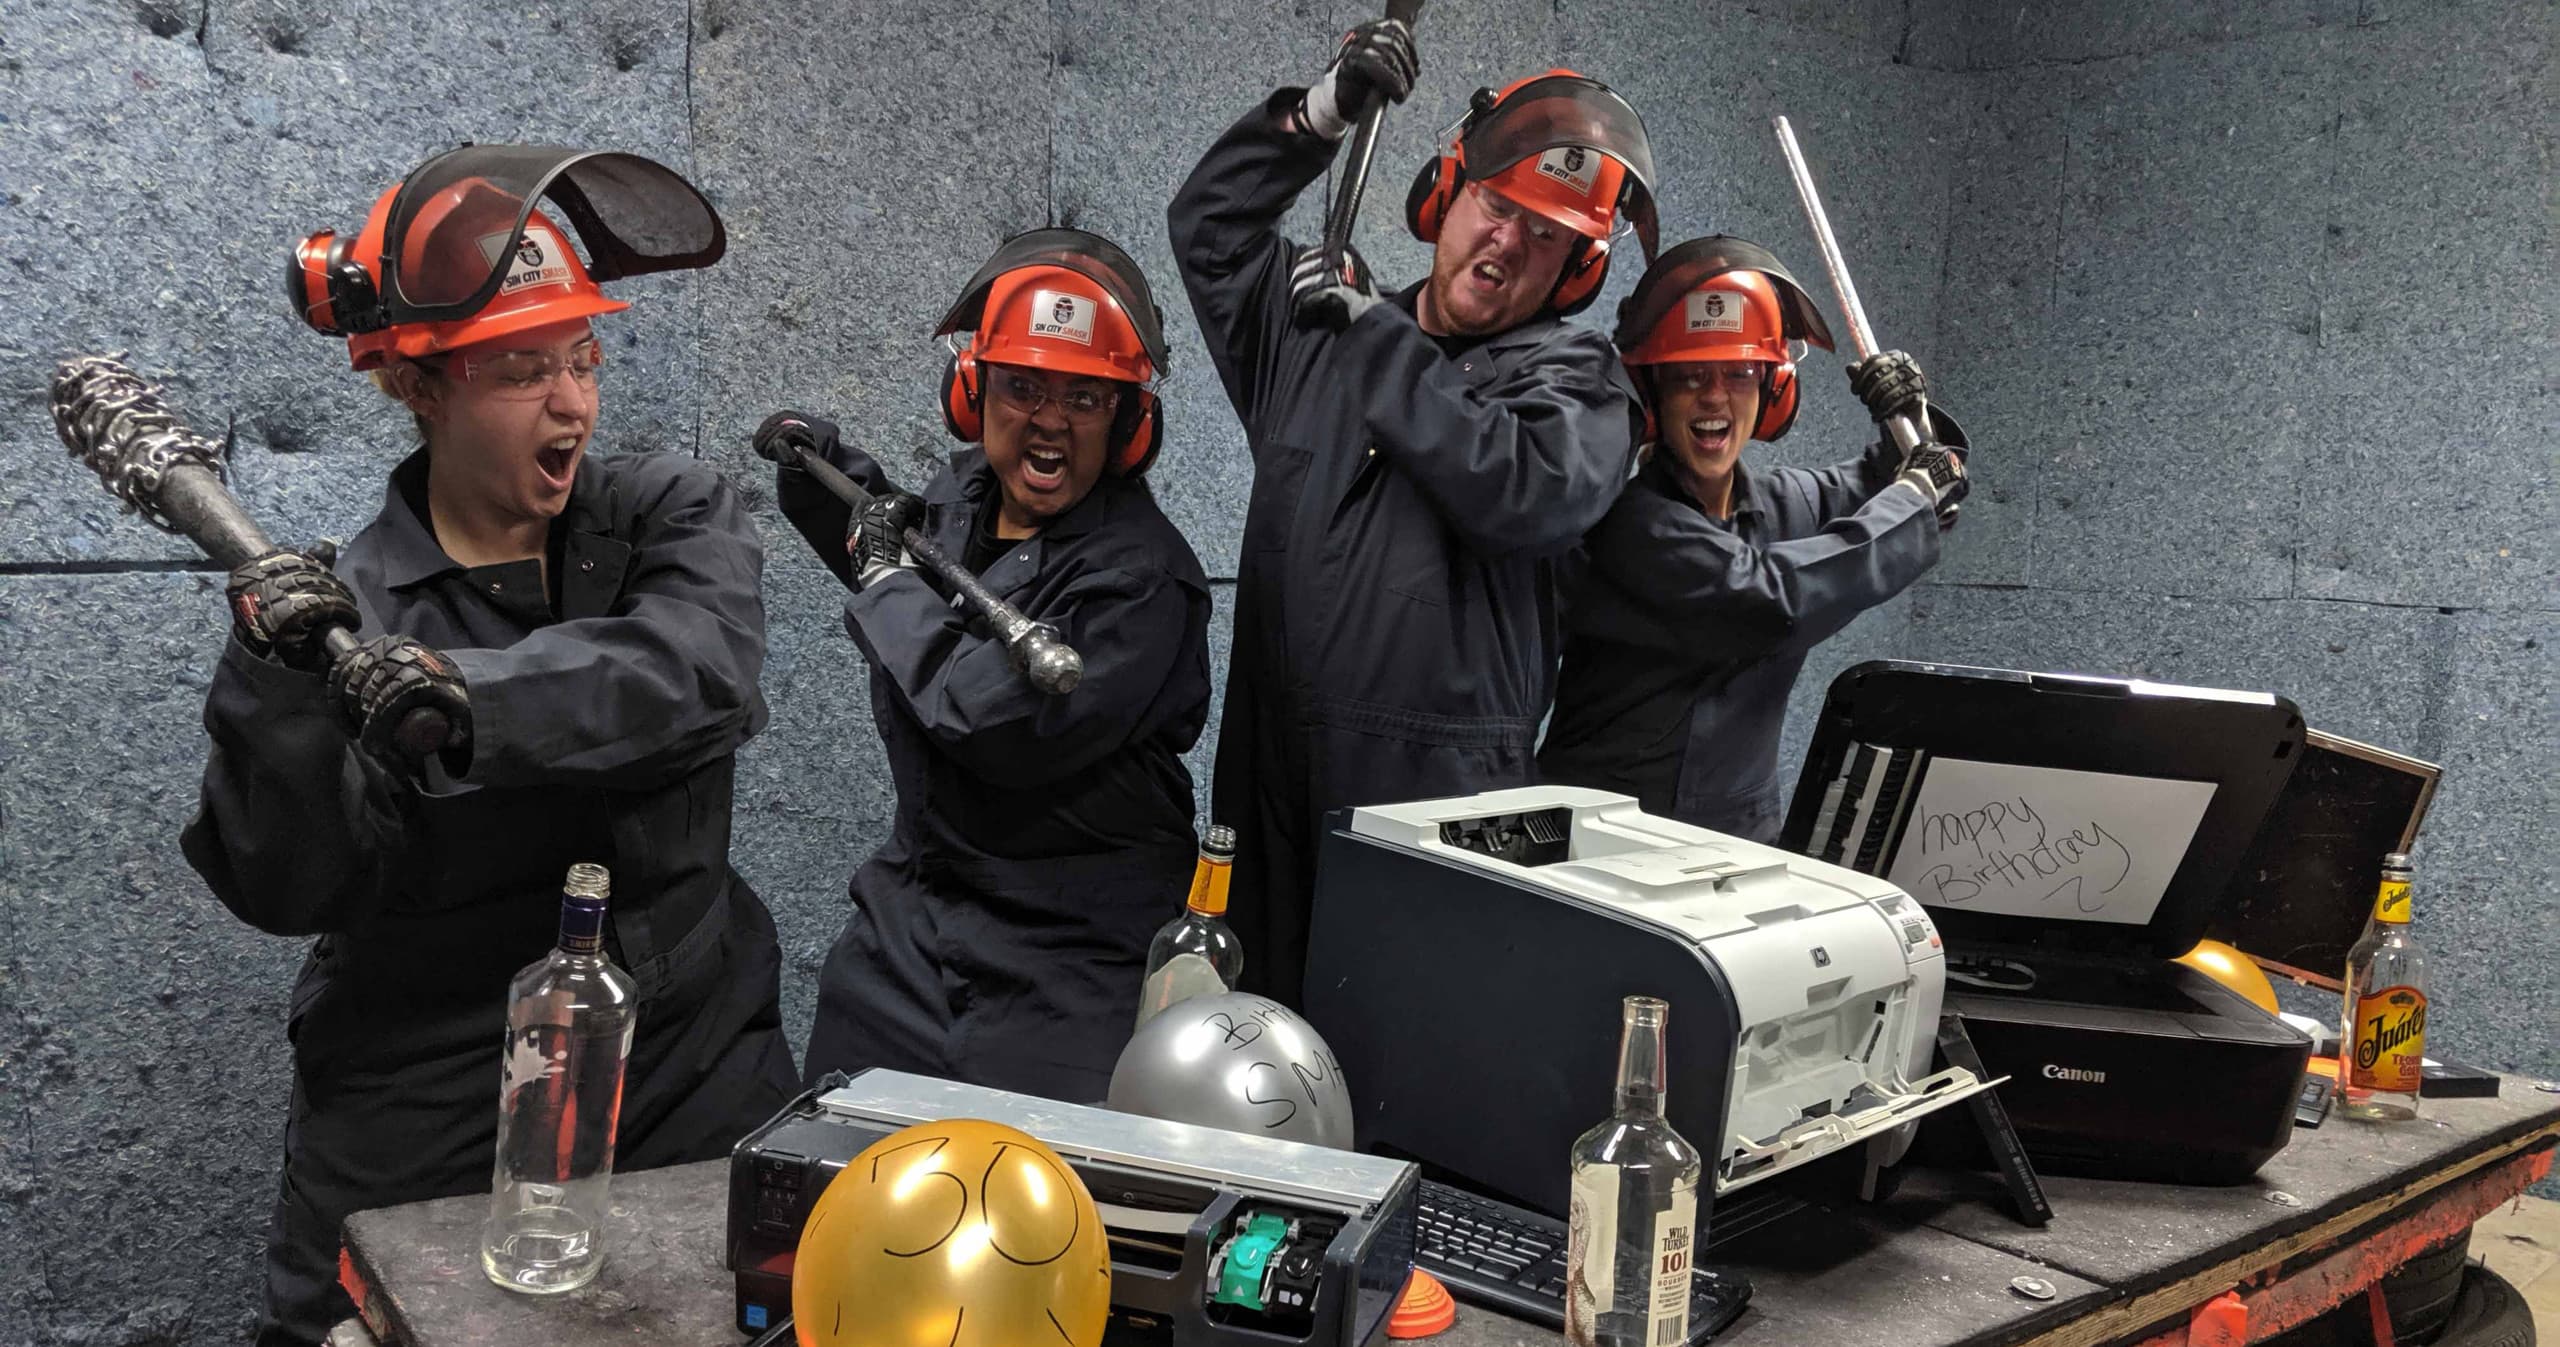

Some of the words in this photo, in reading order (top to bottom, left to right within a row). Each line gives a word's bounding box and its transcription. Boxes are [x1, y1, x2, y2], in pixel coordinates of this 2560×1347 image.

[1542, 163, 1554, 173] SIN
[1554, 168, 1569, 179] CITY
[506, 273, 521, 288] SIN
[523, 270, 541, 283] CITY
[1034, 323, 1046, 332] SIN
[1047, 324, 1062, 333] CITY
[1062, 326, 1088, 339] SMASH
[1702, 319, 1716, 328] CITY
[1920, 796, 2046, 859] happy
[1918, 821, 2131, 904] Birthday
[2042, 1064, 2105, 1084] Canon
[871, 1137, 1079, 1266] 30
[1669, 1226, 1687, 1240] WILD
[1662, 1234, 1689, 1252] TURKEY
[1660, 1250, 1687, 1275] 101
